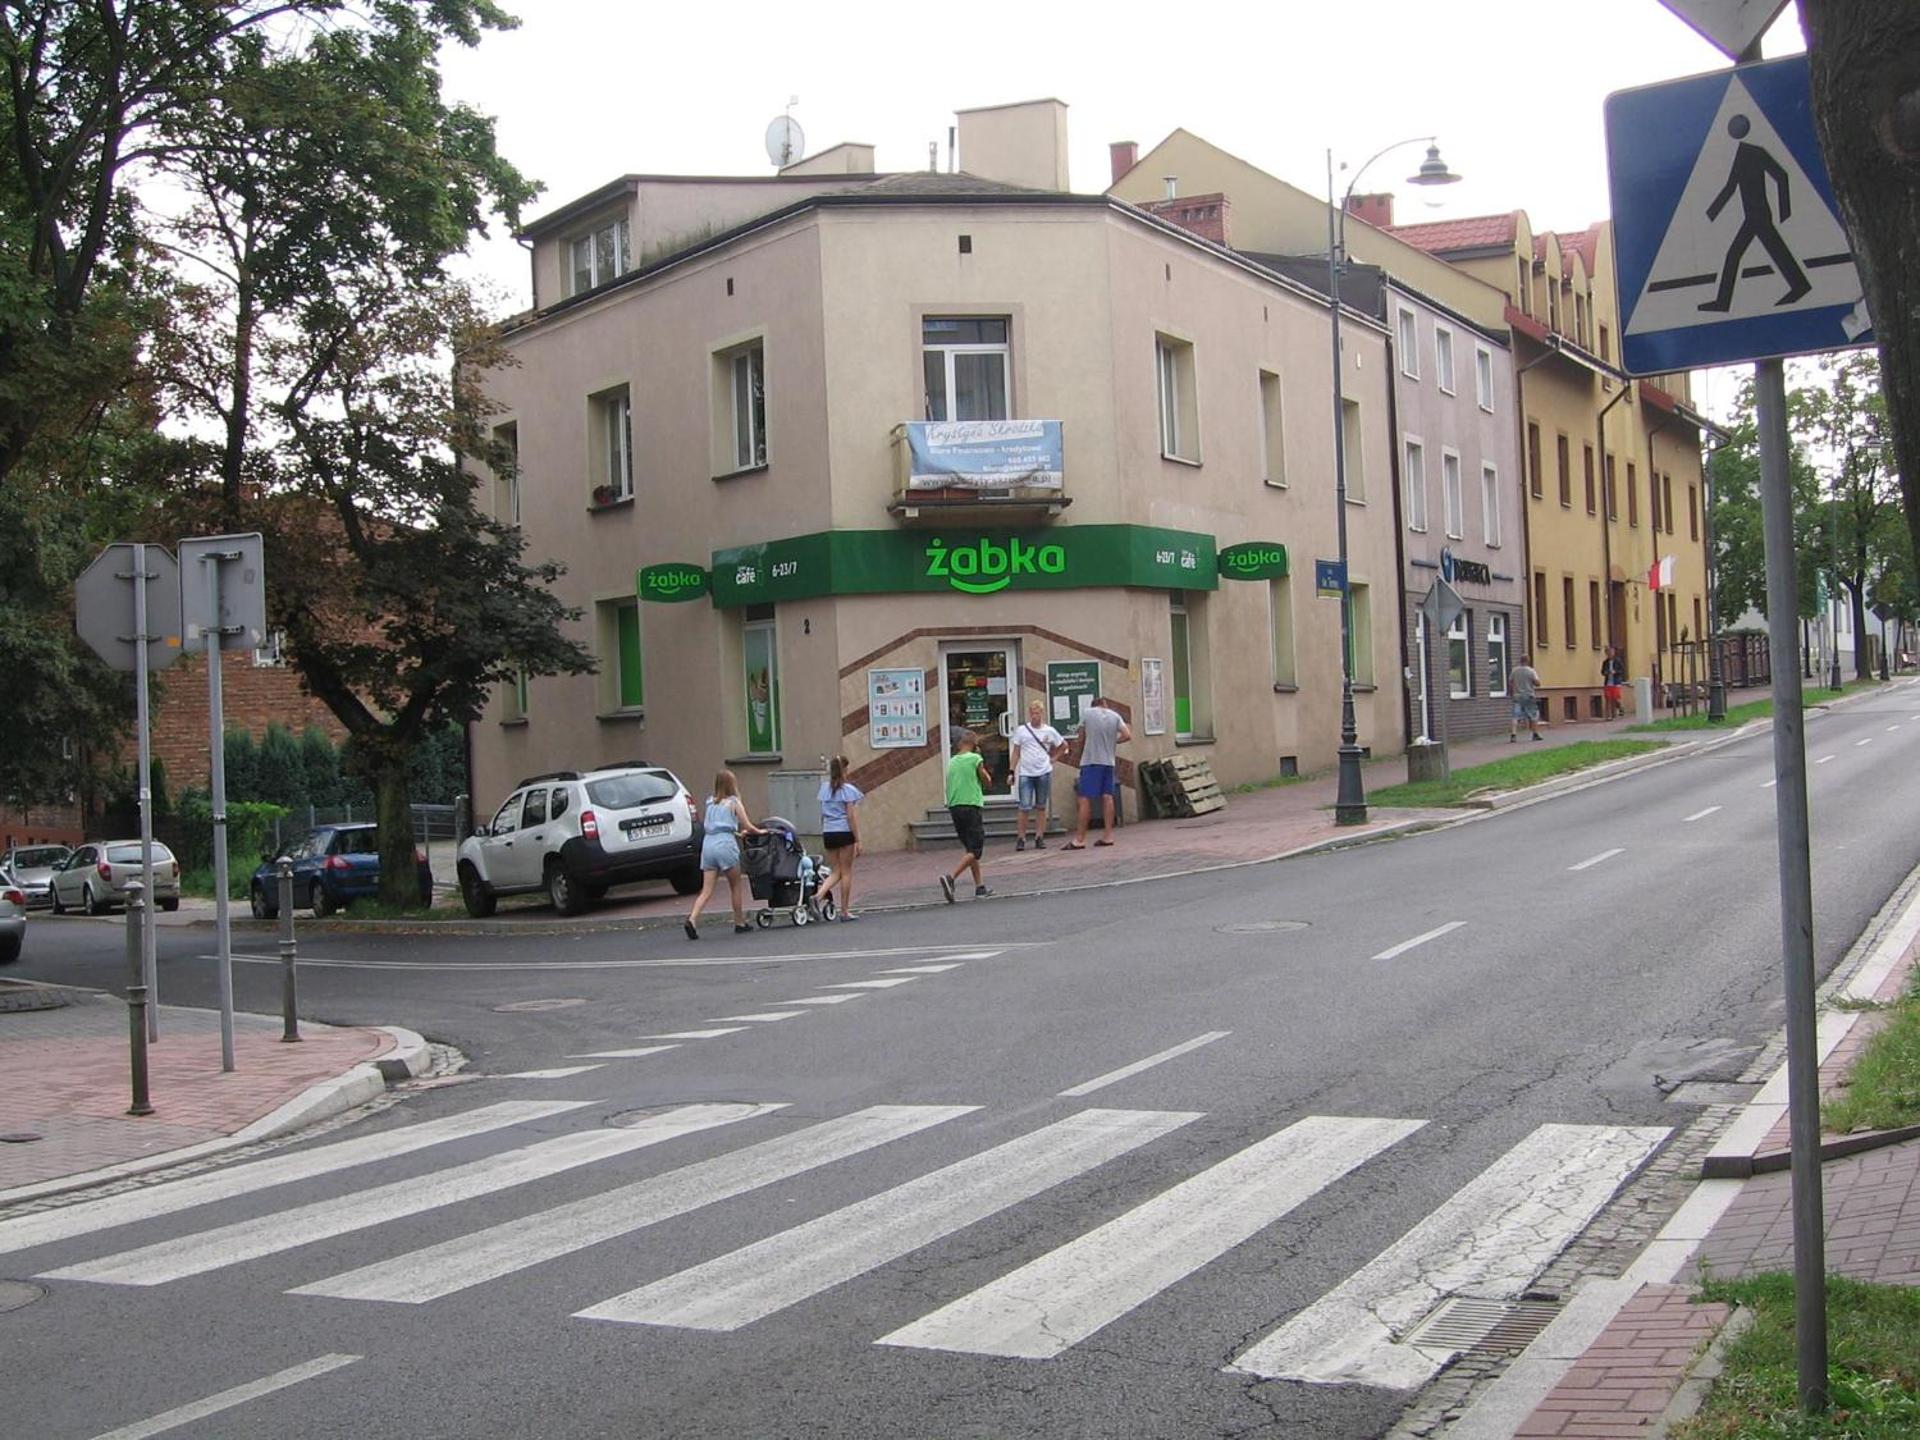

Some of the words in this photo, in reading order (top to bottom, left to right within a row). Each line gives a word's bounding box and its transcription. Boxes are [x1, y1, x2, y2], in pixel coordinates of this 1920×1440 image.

[926, 538, 1066, 576] żabka
[1227, 550, 1281, 567] żabka
[772, 561, 797, 577] 6-23/7
[648, 571, 700, 588] żabka
